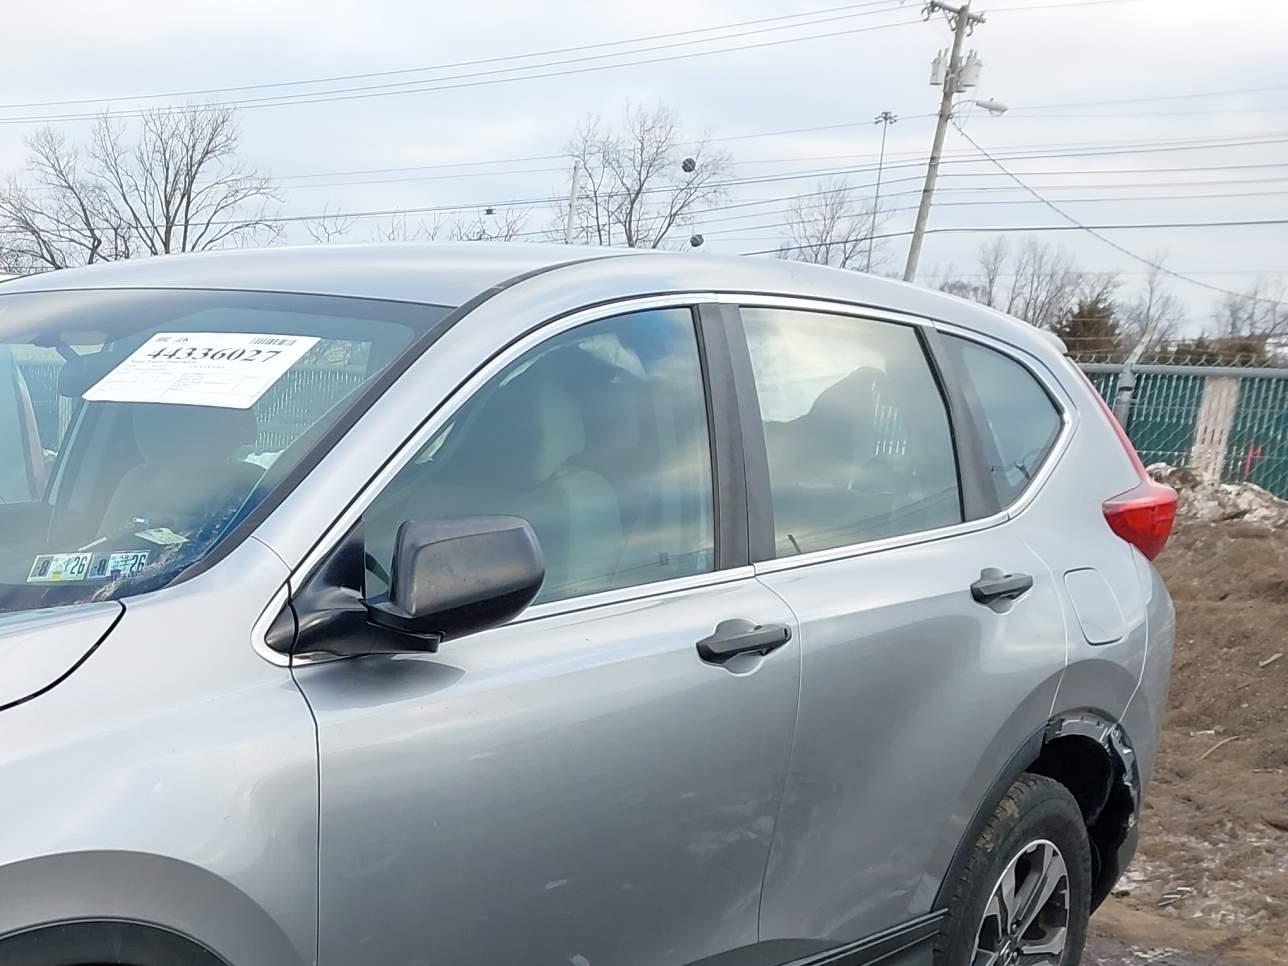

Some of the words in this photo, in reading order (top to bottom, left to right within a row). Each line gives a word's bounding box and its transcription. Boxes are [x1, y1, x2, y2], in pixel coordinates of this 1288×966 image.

[147, 347, 282, 362] 44336027
[69, 556, 88, 575] 26
[129, 554, 147, 574] 26
